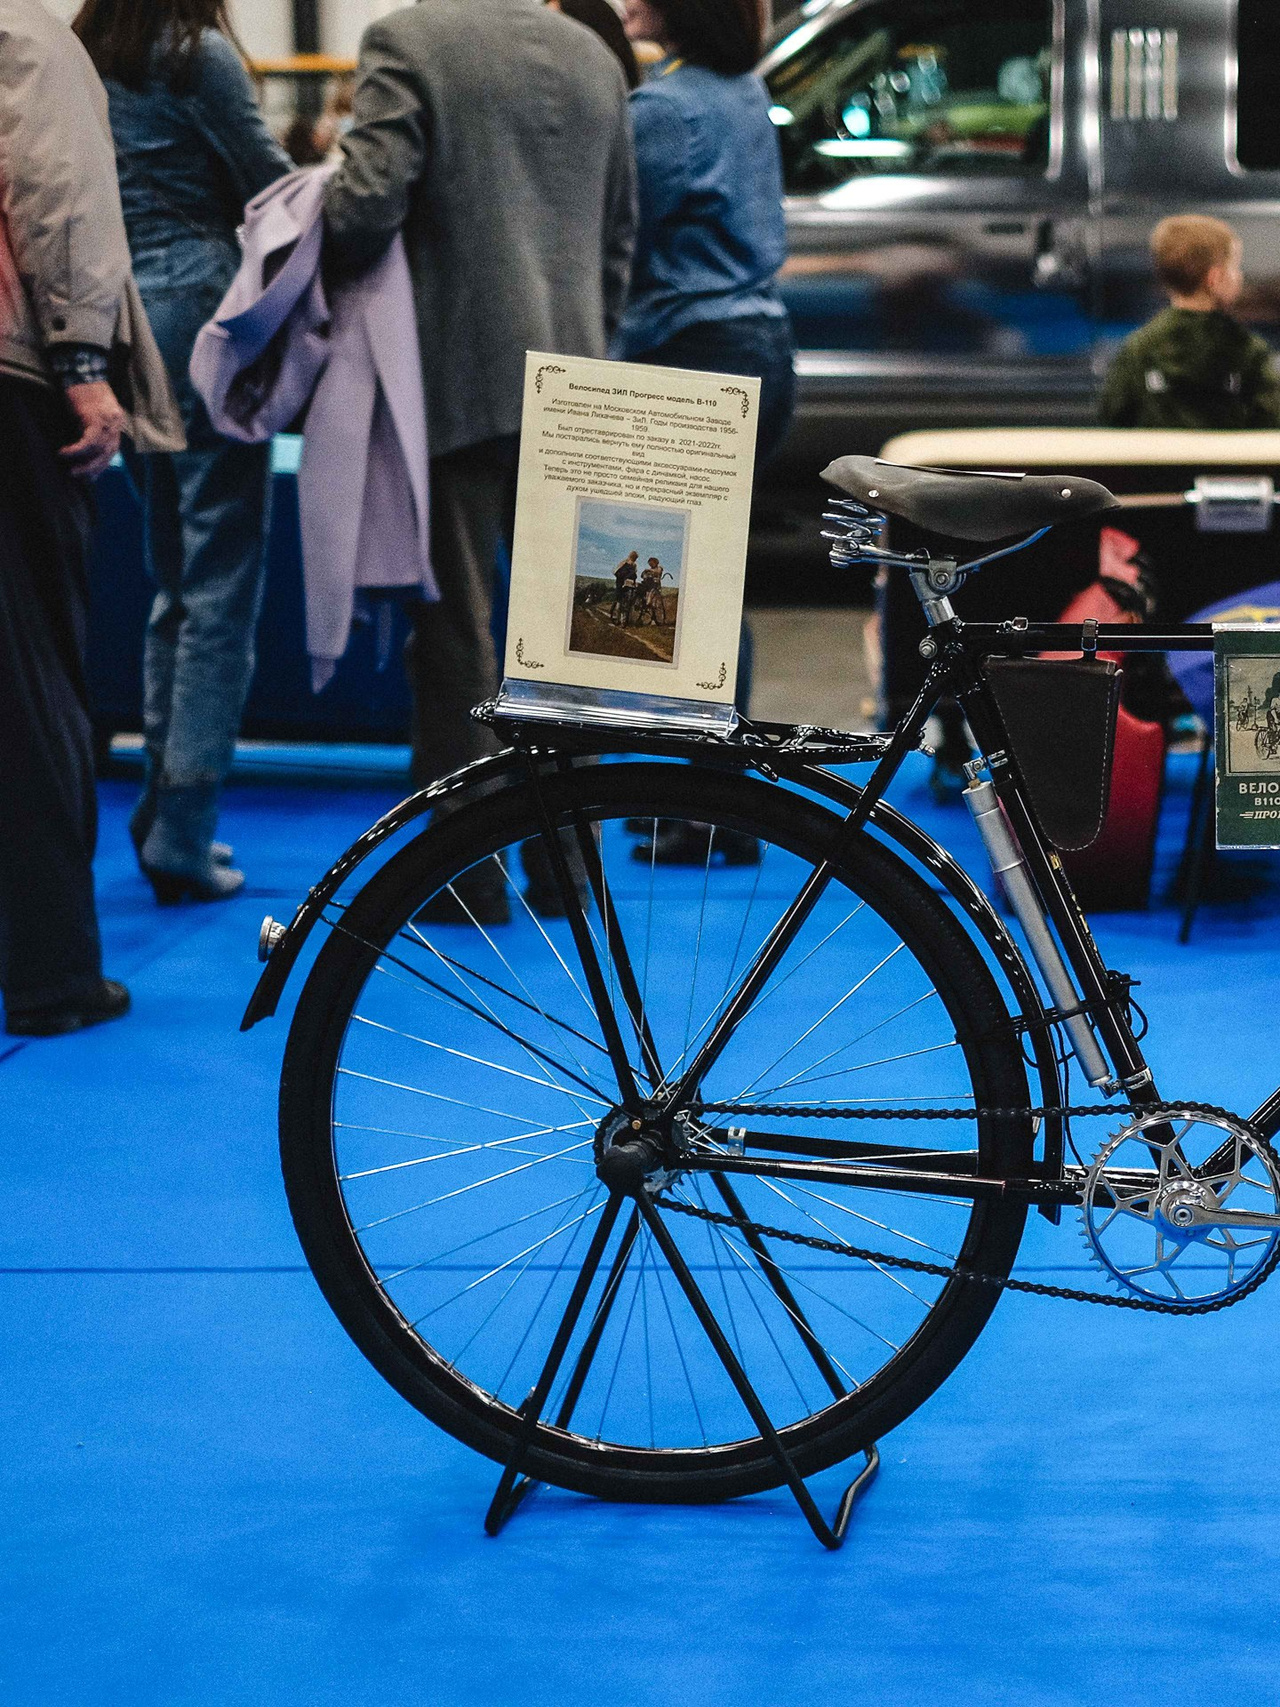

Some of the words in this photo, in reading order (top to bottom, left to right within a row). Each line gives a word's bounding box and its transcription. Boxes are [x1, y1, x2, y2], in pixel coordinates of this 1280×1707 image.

[568, 383, 610, 395] Велосипед
[612, 388, 628, 396] ЗИЛ
[630, 390, 664, 401] Прогресс
[667, 395, 695, 405] модель
[697, 398, 717, 407] В-110
[543, 406, 566, 414] имени
[567, 409, 589, 417] Ивана
[591, 411, 624, 421] Лихачева
[650, 418, 668, 427] Годы
[670, 421, 717, 433] производства
[551, 398, 592, 408] Изготовлен
[604, 404, 646, 415] Московском
[648, 410, 704, 422] Автомобильном
[706, 416, 731, 426] Заводе
[542, 430, 554, 438] Мы
[555, 433, 600, 444] постарались
[602, 439, 629, 448] вернуть
[646, 444, 685, 454] полностью
[686, 449, 737, 460] оригинальный
[557, 424, 573, 432] Был
[574, 426, 634, 439] отреставрирован
[647, 435, 669, 444] заказу
[544, 449, 583, 459] дополнили
[585, 453, 652, 466] соответствующими
[543, 464, 568, 473] Теперь
[593, 471, 618, 480] просто
[619, 474, 653, 483] семейная
[704, 484, 730, 493] нашего
[625, 466, 645, 475] фара
[543, 474, 585, 484] уважаемого
[642, 485, 684, 496] прекрасный
